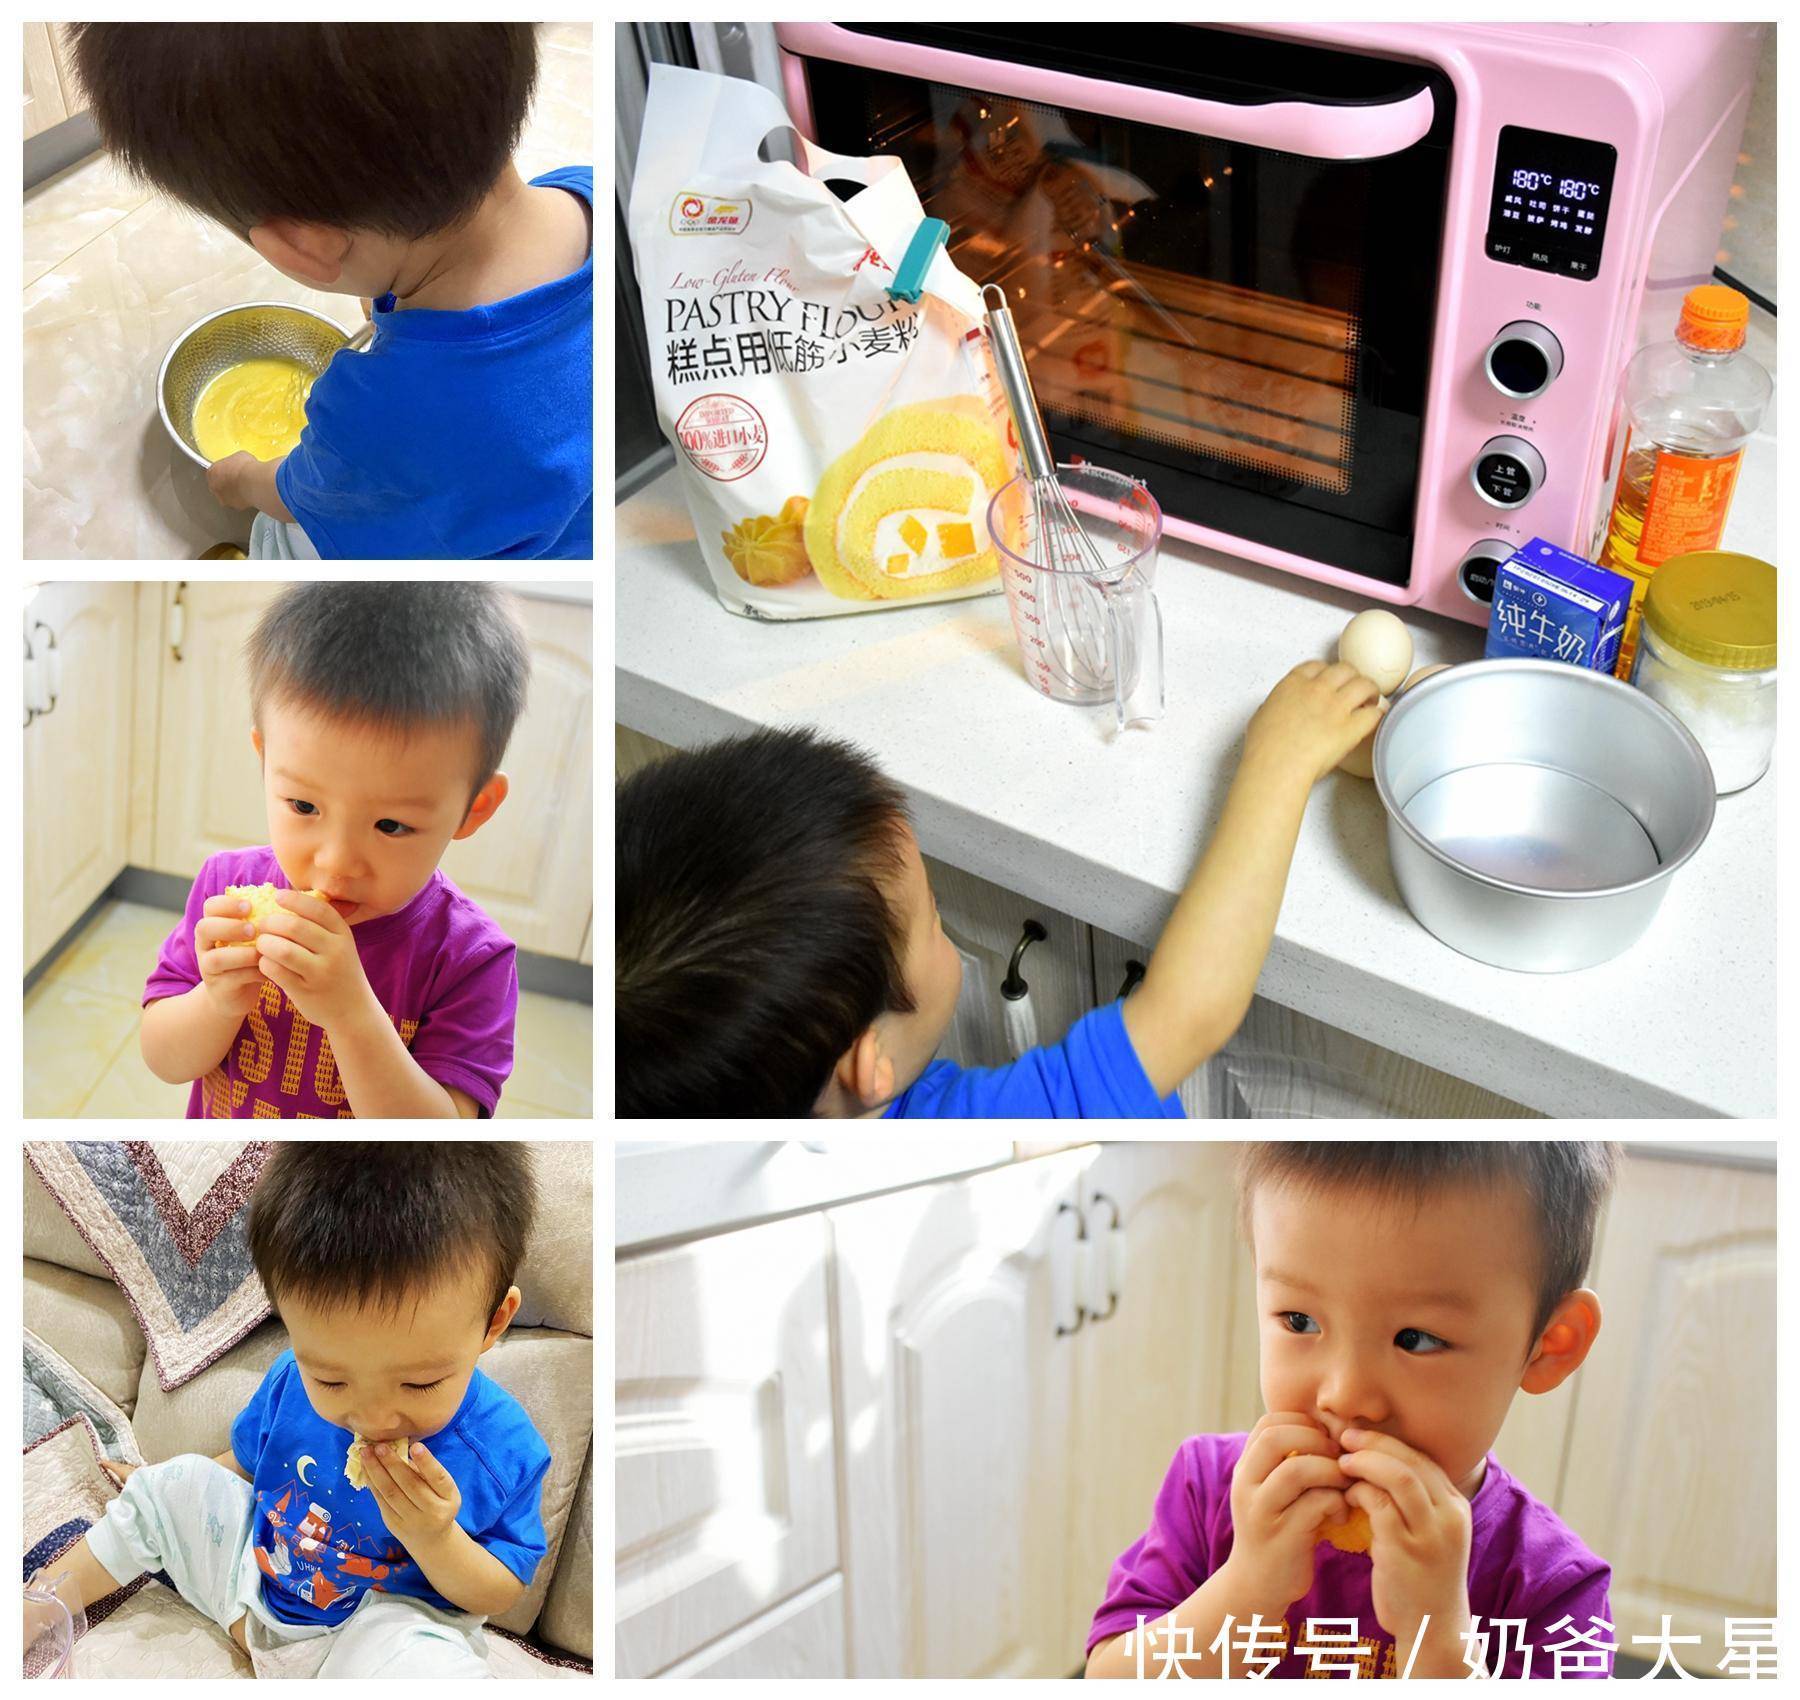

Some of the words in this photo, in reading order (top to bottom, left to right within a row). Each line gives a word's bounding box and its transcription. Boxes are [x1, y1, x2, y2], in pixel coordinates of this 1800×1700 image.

[1529, 200, 1547, 210] 吐司
[1553, 204, 1570, 215] 饼干
[1575, 224, 1593, 235] 发酵
[670, 259, 757, 290] Low-Gluten
[665, 290, 793, 333] PASTRY
[800, 299, 918, 340] FLOU
[667, 314, 920, 385] 糕点用低筋小麦粉
[1497, 599, 1586, 664] 纯牛奶
